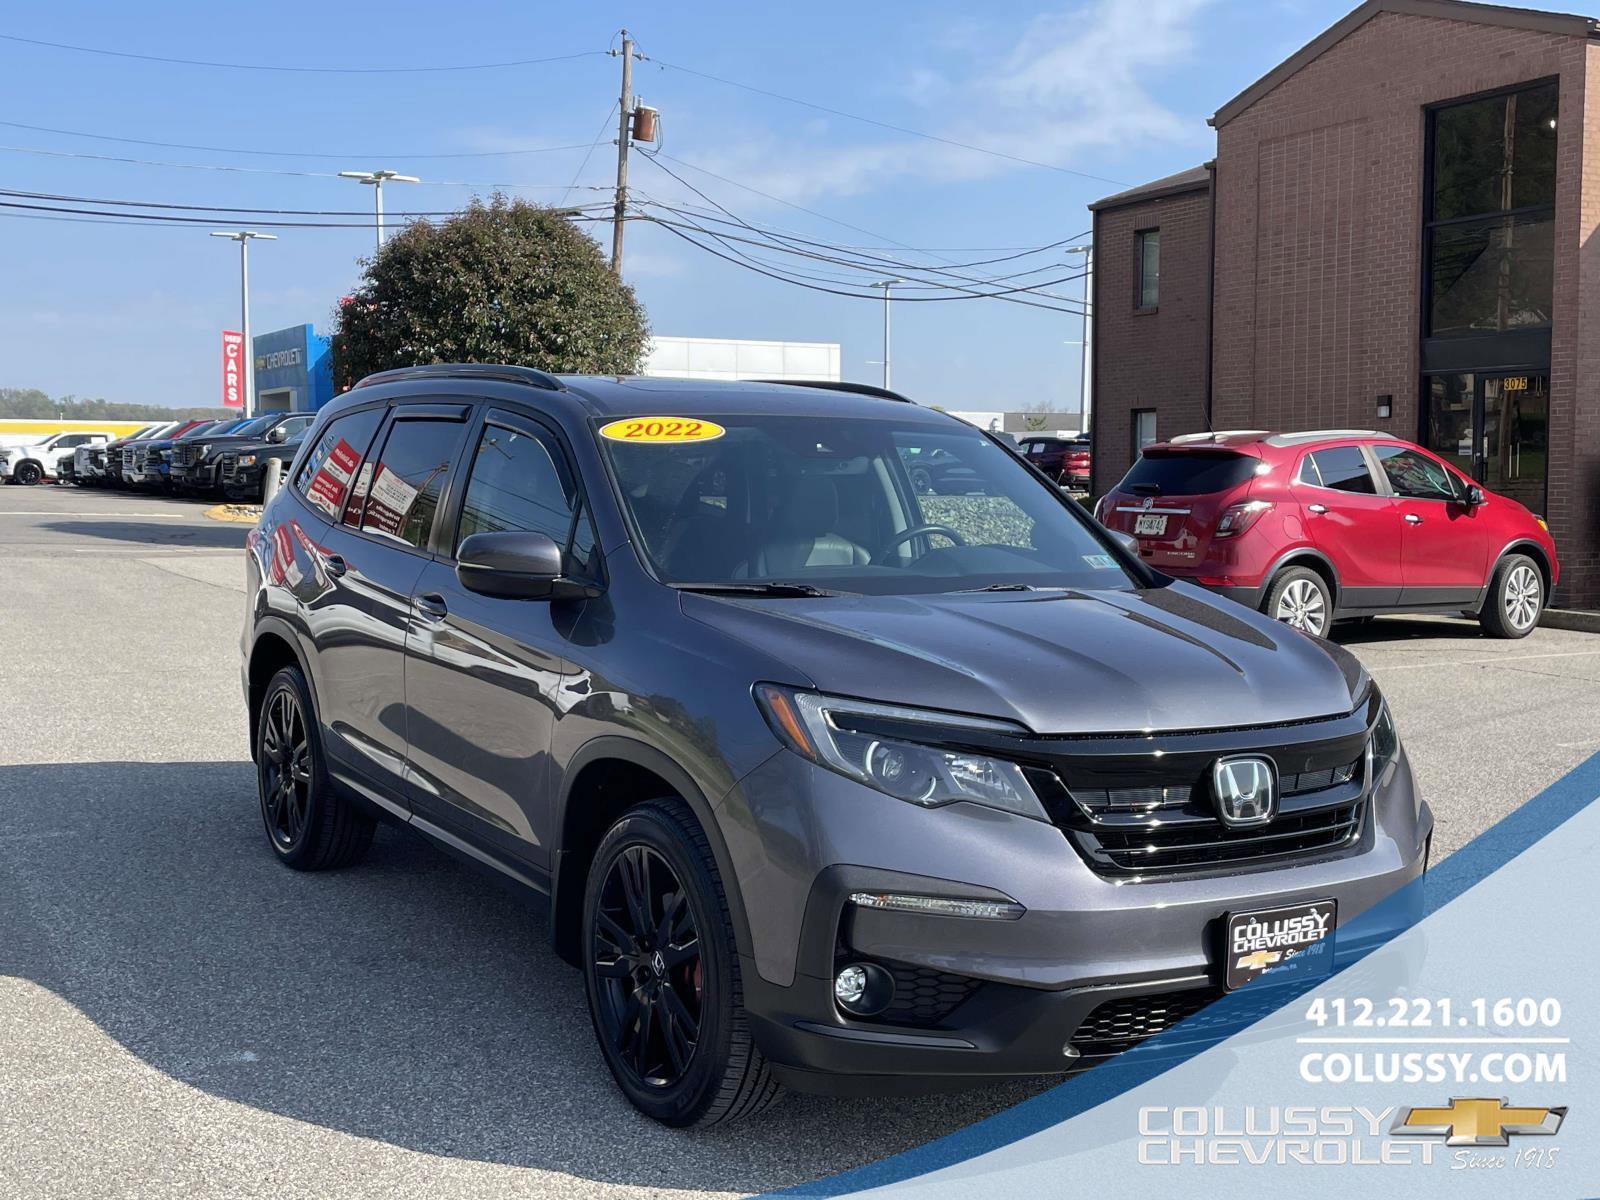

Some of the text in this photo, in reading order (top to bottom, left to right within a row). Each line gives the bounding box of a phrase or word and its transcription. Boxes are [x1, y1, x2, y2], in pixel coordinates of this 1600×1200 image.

[265, 347, 301, 366] CHEVROLET
[226, 343, 239, 401] CARS
[1505, 378, 1527, 389] 3075
[624, 422, 702, 438] 2022
[1233, 912, 1330, 942] COLUSSY
[1233, 928, 1328, 953] CHEVROLET
